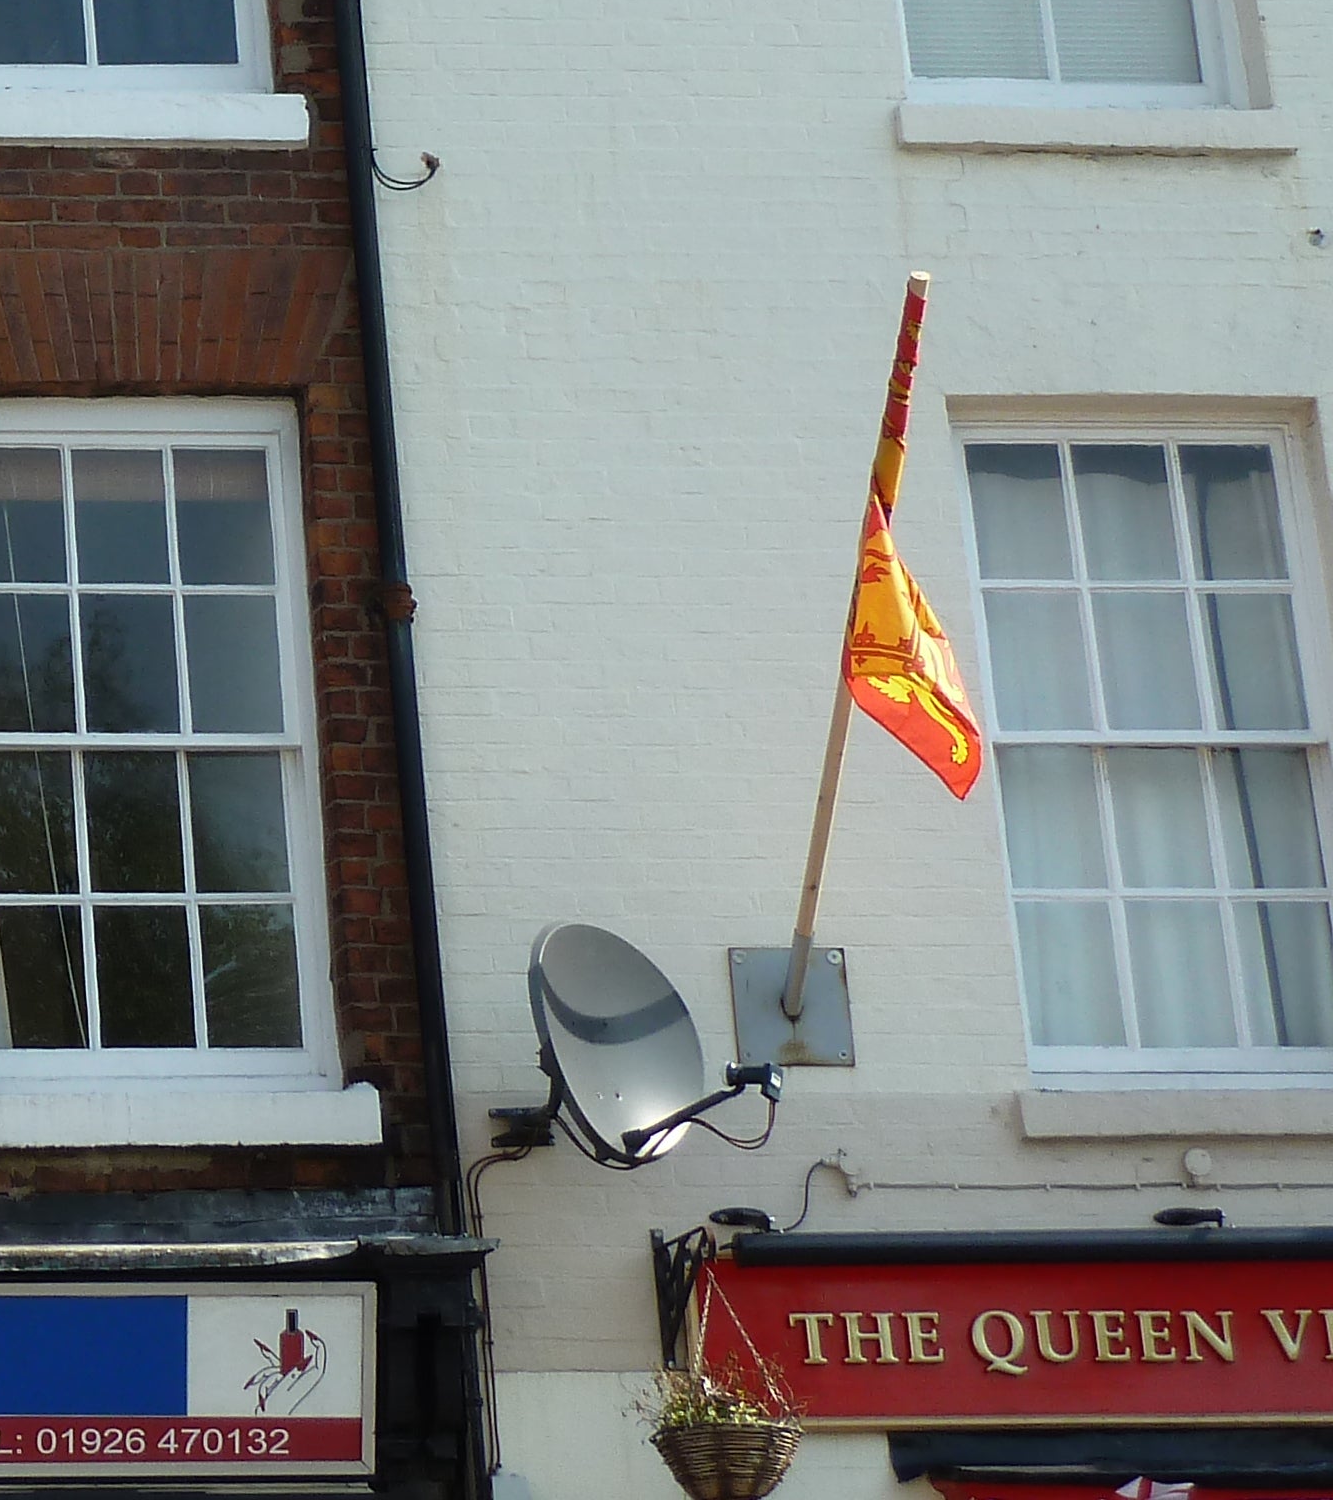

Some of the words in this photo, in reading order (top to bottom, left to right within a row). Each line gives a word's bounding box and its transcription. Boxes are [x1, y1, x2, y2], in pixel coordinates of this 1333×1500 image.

[788, 1311, 945, 1365] THE
[971, 1310, 1234, 1375] QUEEN
[35, 1428, 146, 1455] 01926
[157, 1428, 290, 1455] 470132
